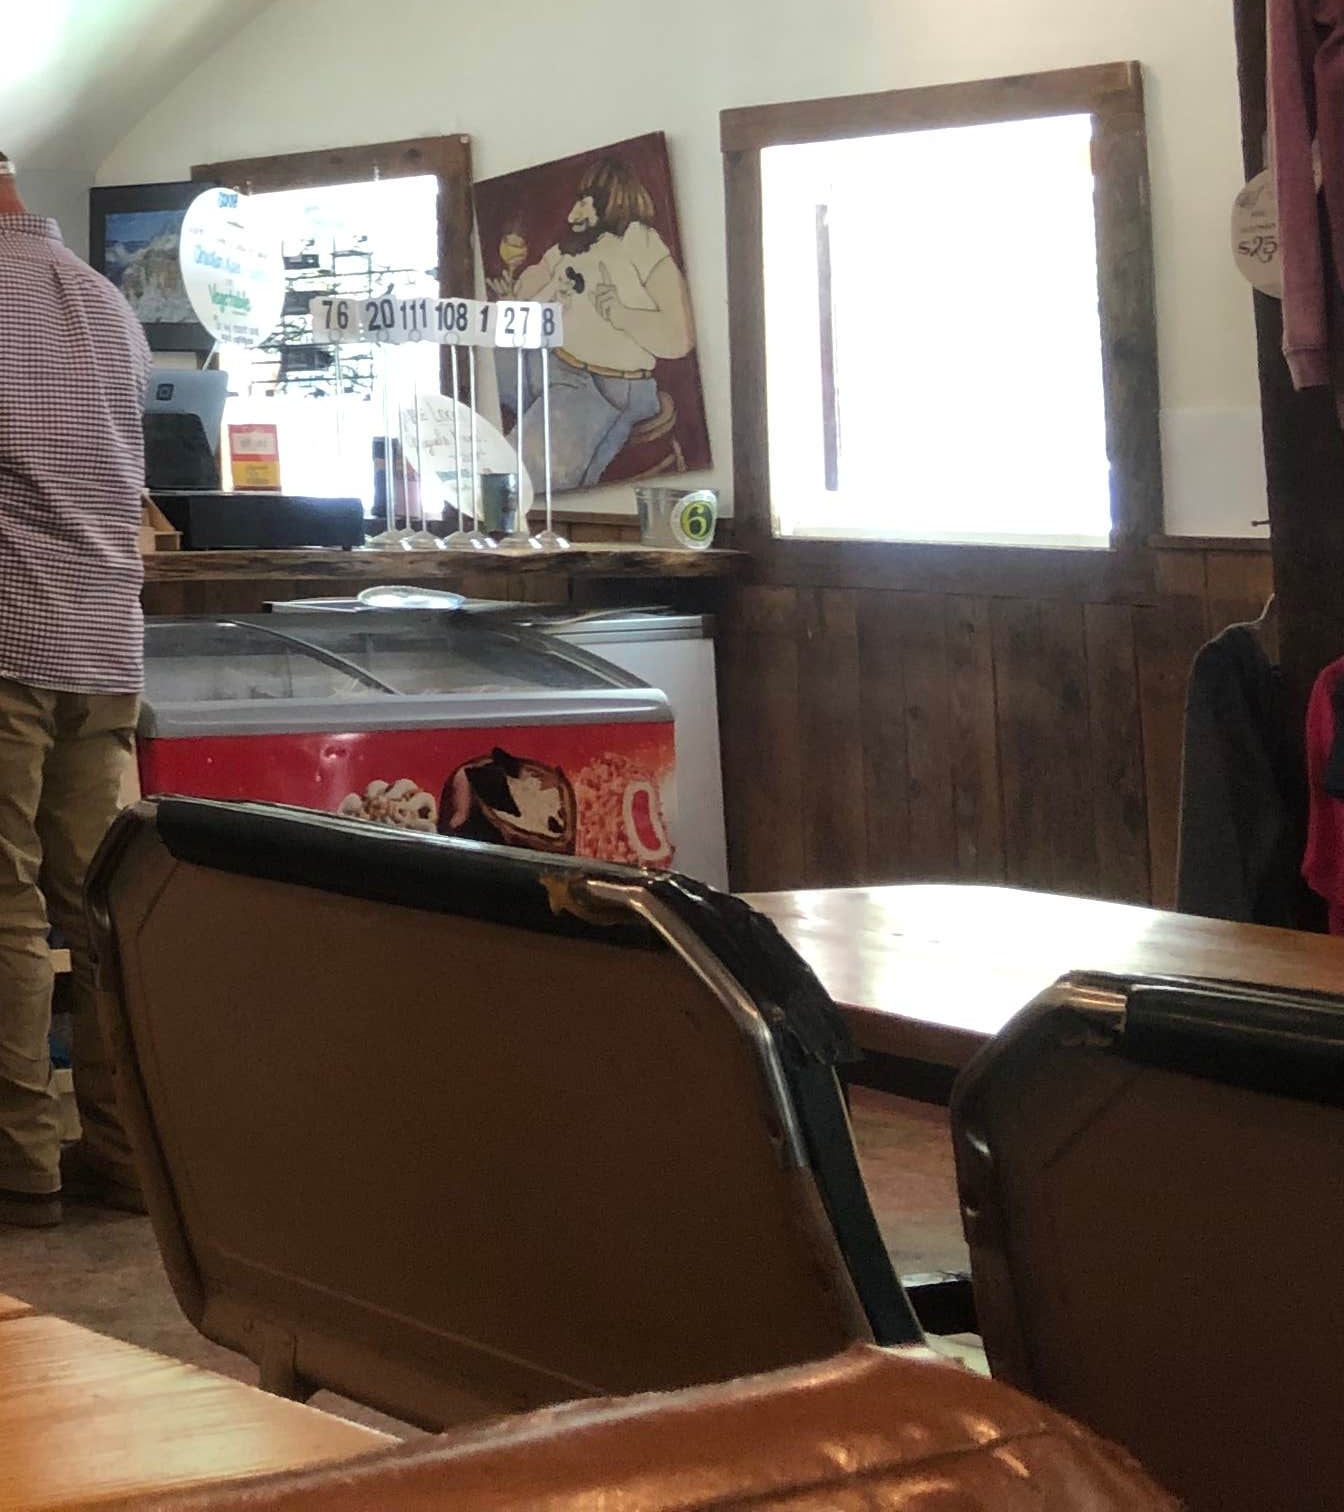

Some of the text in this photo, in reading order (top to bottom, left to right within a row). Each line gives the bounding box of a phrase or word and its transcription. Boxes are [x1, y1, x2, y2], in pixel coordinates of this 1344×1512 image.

[321, 300, 349, 330] 76
[365, 298, 396, 332] 20
[399, 298, 428, 331] 111
[434, 301, 469, 332] 108
[503, 306, 530, 335] 27
[682, 501, 708, 540] 6
